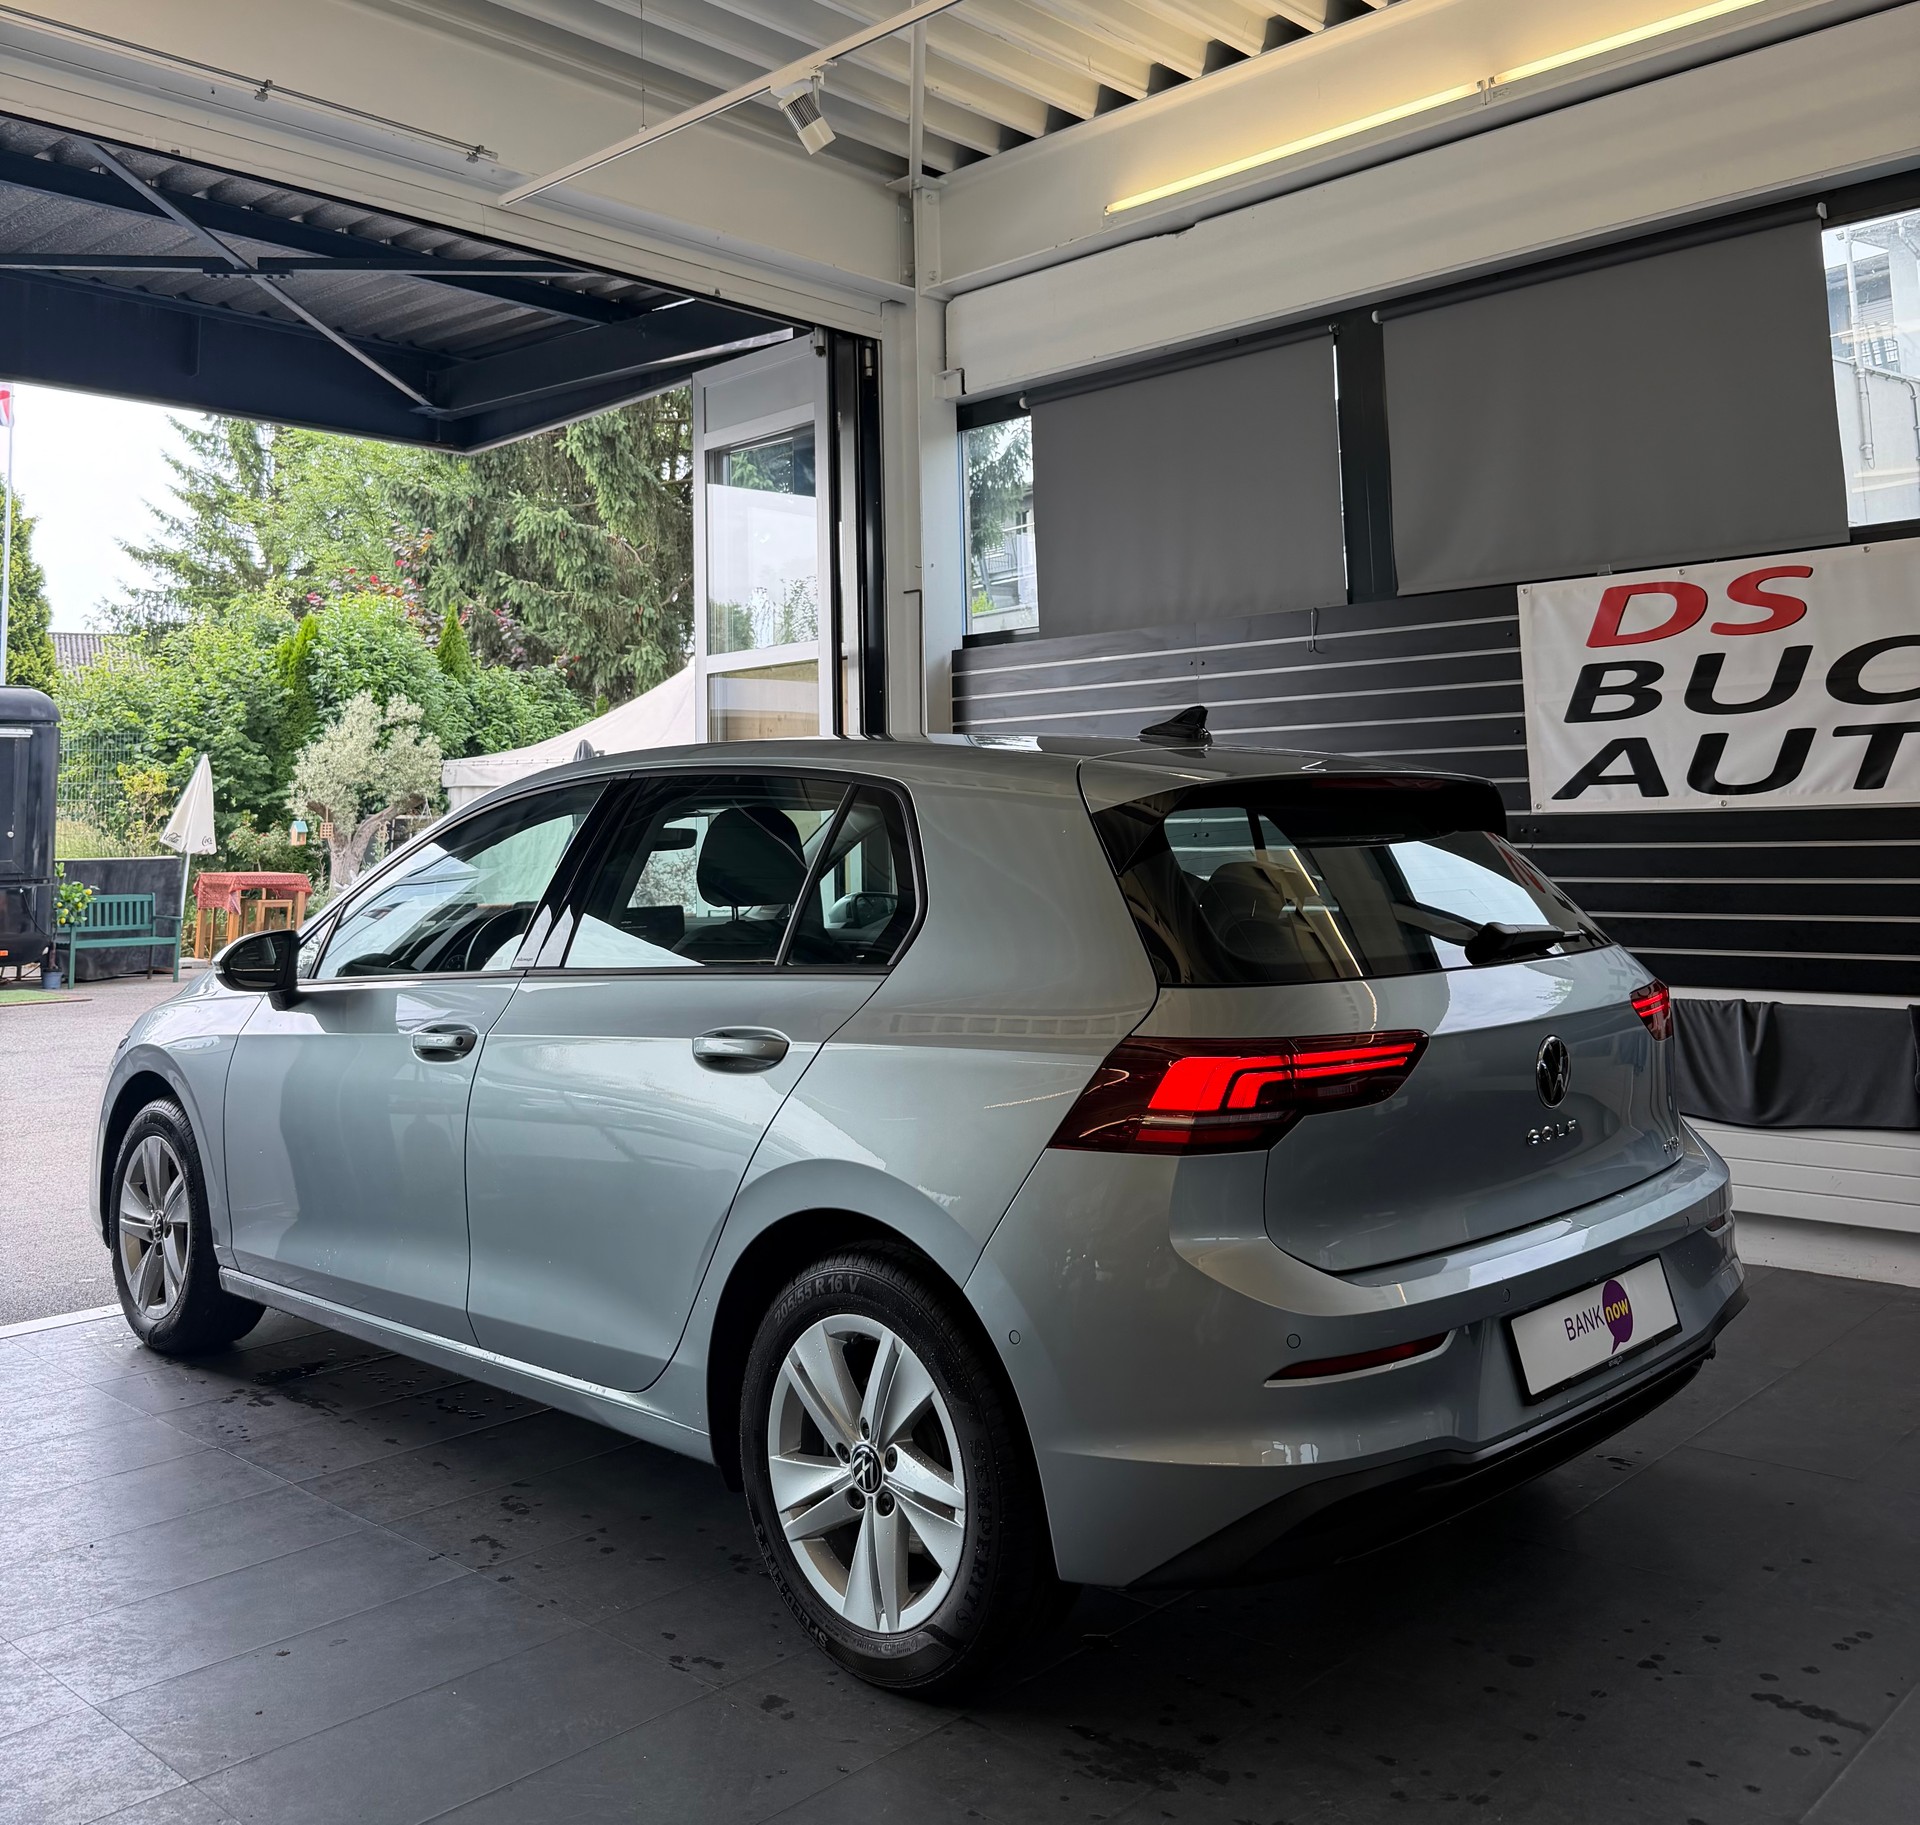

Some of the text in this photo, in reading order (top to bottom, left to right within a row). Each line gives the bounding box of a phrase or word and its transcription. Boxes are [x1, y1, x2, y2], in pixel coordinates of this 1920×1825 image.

[1586, 566, 1814, 648] DS
[1552, 721, 1920, 800] AUT
[1527, 1119, 1577, 1146] GOLF
[774, 1282, 812, 1323] 205/55
[827, 1274, 843, 1293] 16
[848, 1275, 860, 1293] V
[1564, 1298, 1629, 1341] BANK now
